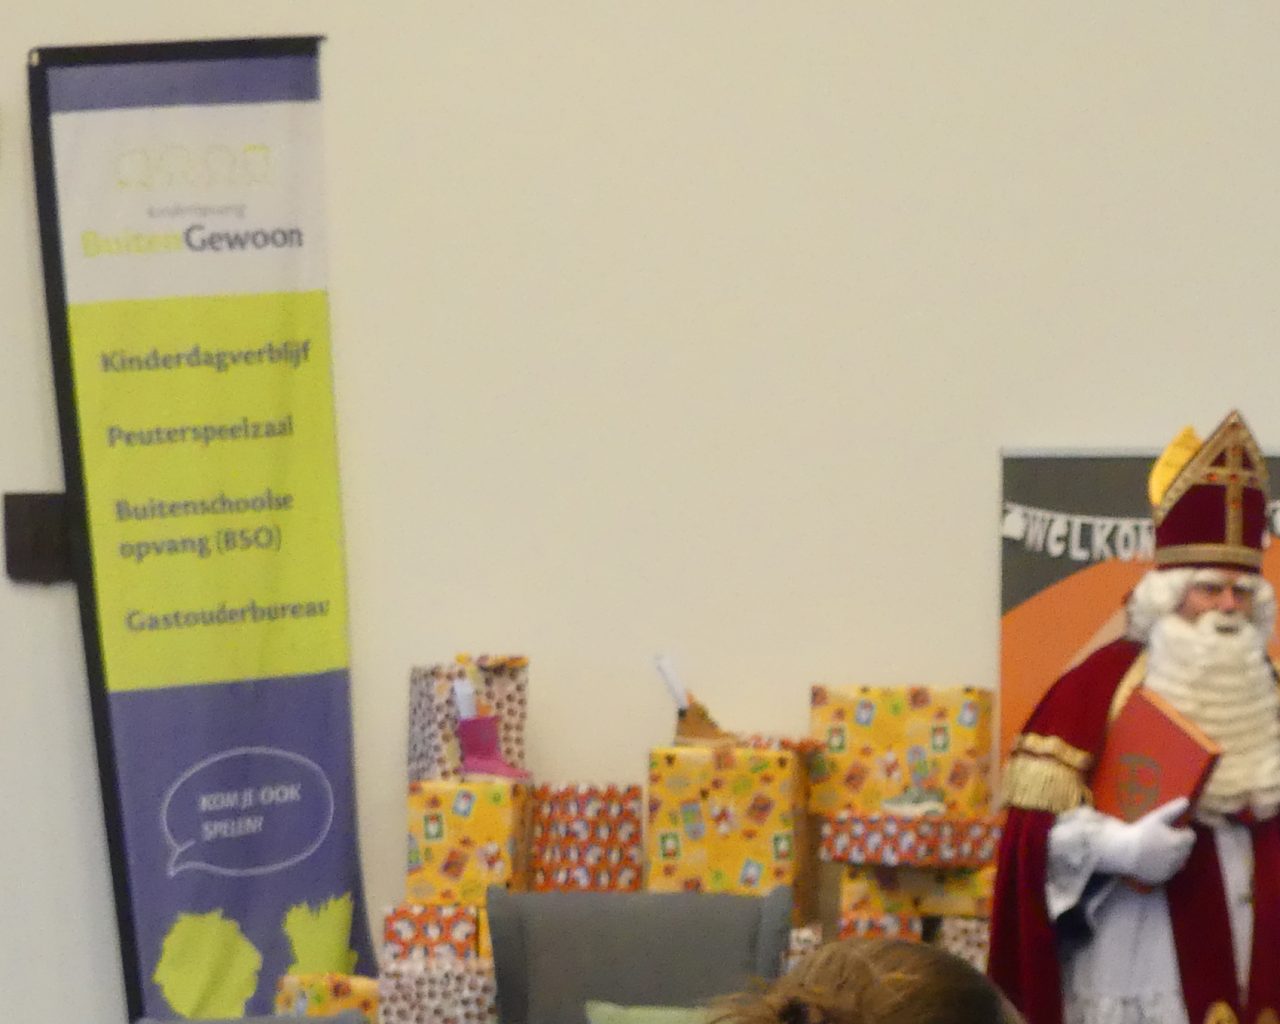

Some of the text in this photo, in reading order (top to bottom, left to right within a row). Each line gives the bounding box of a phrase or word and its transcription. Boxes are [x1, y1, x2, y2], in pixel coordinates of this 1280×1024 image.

[101, 340, 311, 372] Kinderdagverblijf
[108, 416, 293, 447] Peuterspeelzaal
[117, 488, 293, 520] Buitenschoolse
[119, 524, 282, 562] opvang (BSO)
[260, 783, 301, 804] OOK
